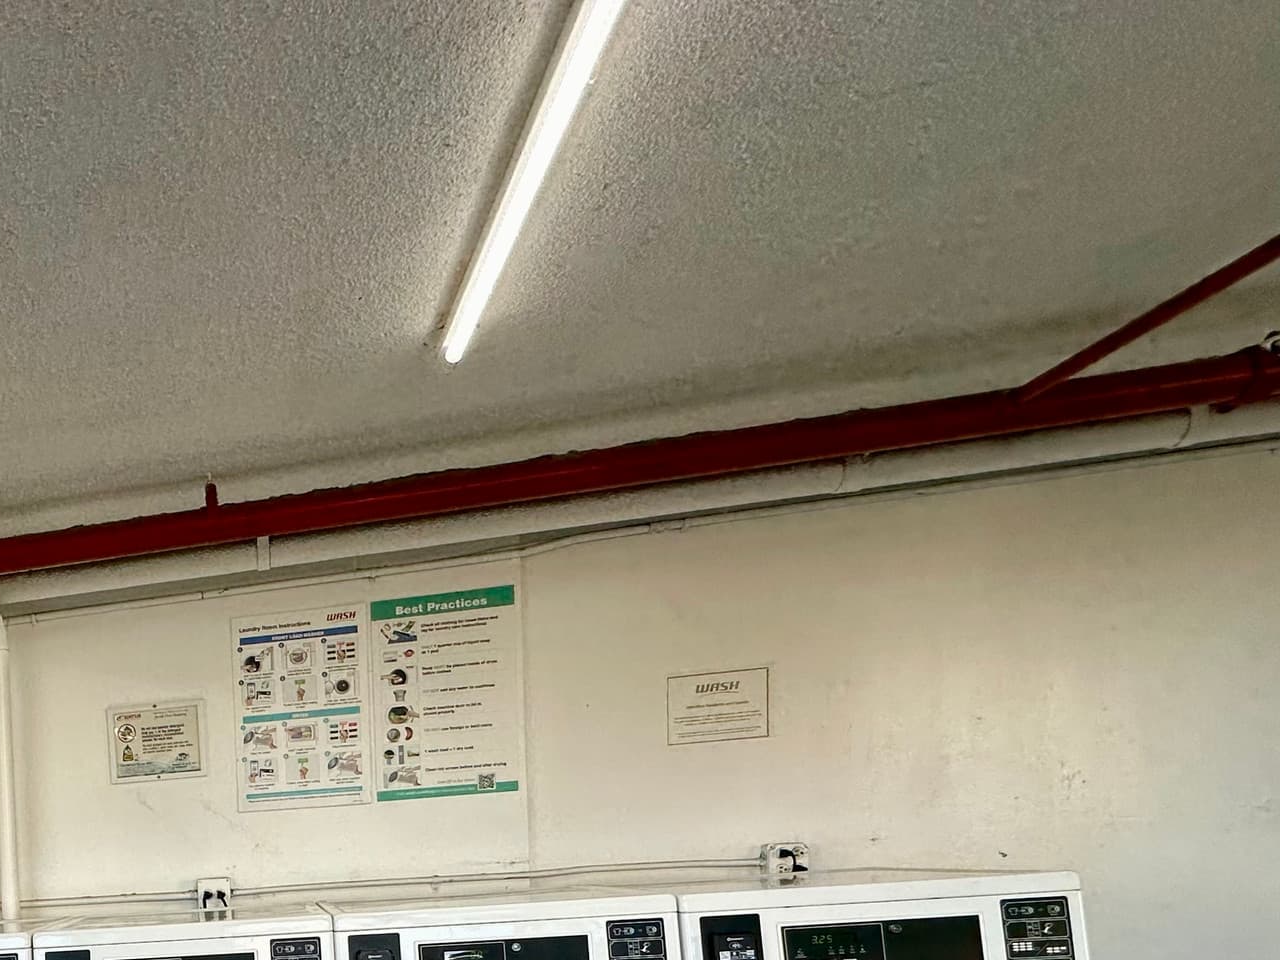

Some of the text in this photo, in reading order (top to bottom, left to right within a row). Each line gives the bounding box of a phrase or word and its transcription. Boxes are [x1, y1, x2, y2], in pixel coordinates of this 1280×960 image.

[395, 597, 488, 615] Best Practices
[326, 611, 356, 621] WASH
[695, 680, 740, 694] WASH
